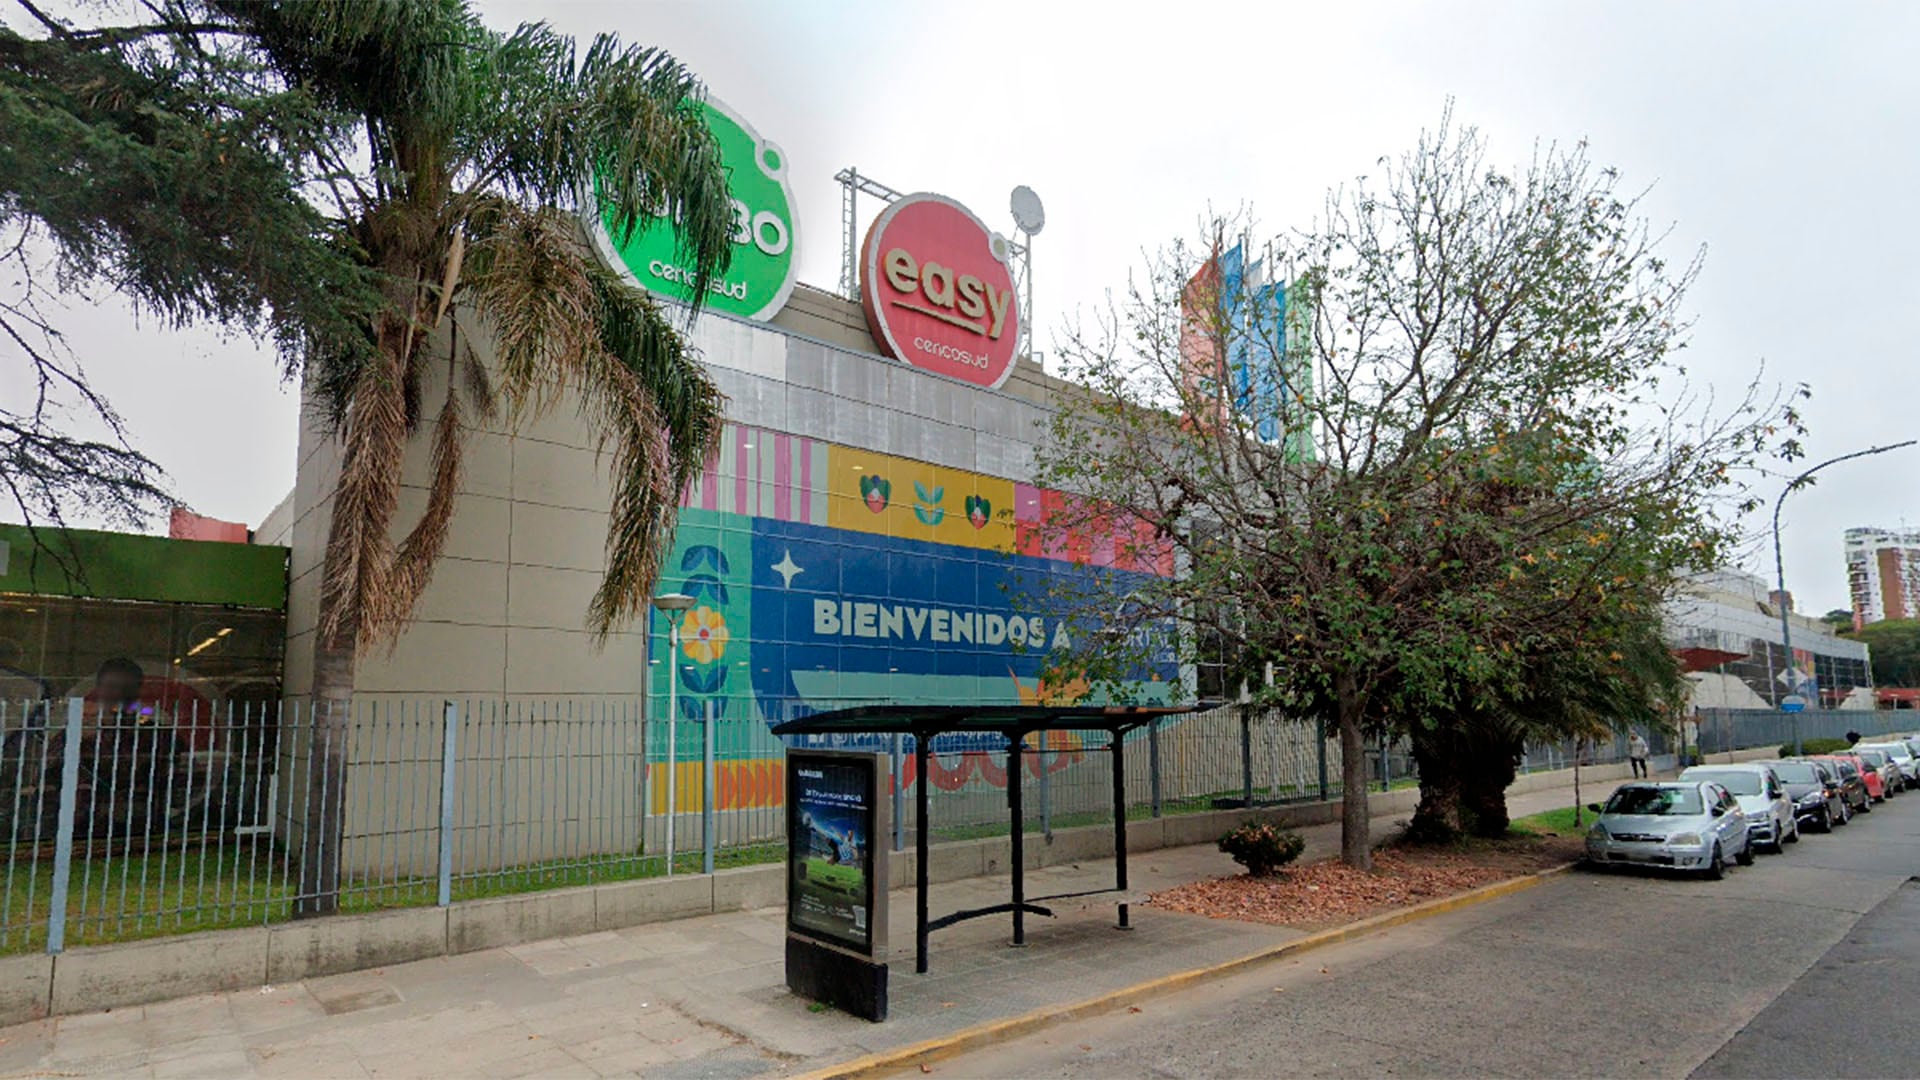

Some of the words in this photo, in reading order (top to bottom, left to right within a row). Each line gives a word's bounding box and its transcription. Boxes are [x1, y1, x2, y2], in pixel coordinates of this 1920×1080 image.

[649, 260, 747, 299] cencsud
[885, 247, 1011, 340] easy
[913, 336, 989, 369] cencosud
[814, 598, 1045, 648] BIENVENIDOS
[1052, 621, 1071, 648] A
